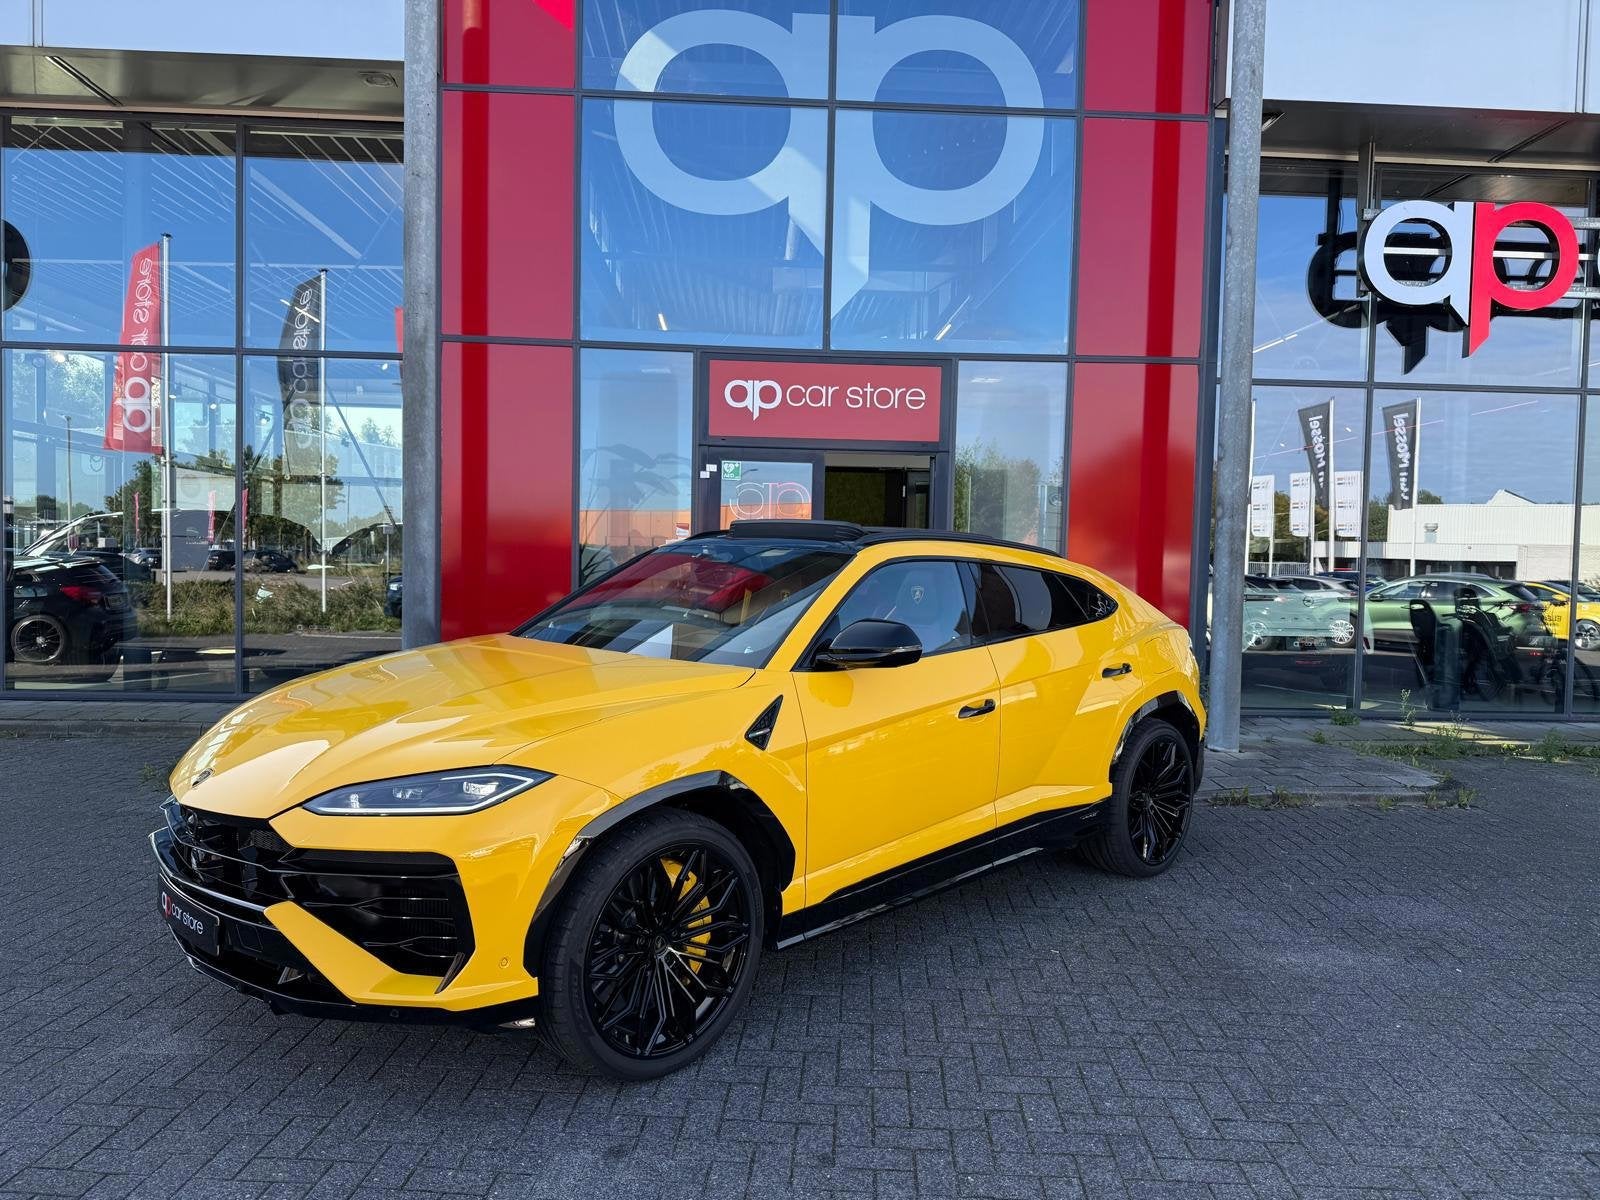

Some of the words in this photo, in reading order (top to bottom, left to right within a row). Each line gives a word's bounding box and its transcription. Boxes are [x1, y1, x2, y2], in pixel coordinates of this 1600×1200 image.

[1364, 200, 1580, 358] ap
[724, 379, 783, 421] ap
[786, 384, 839, 407] car
[846, 382, 926, 410] store
[171, 903, 182, 920] car
[182, 911, 204, 935] store
